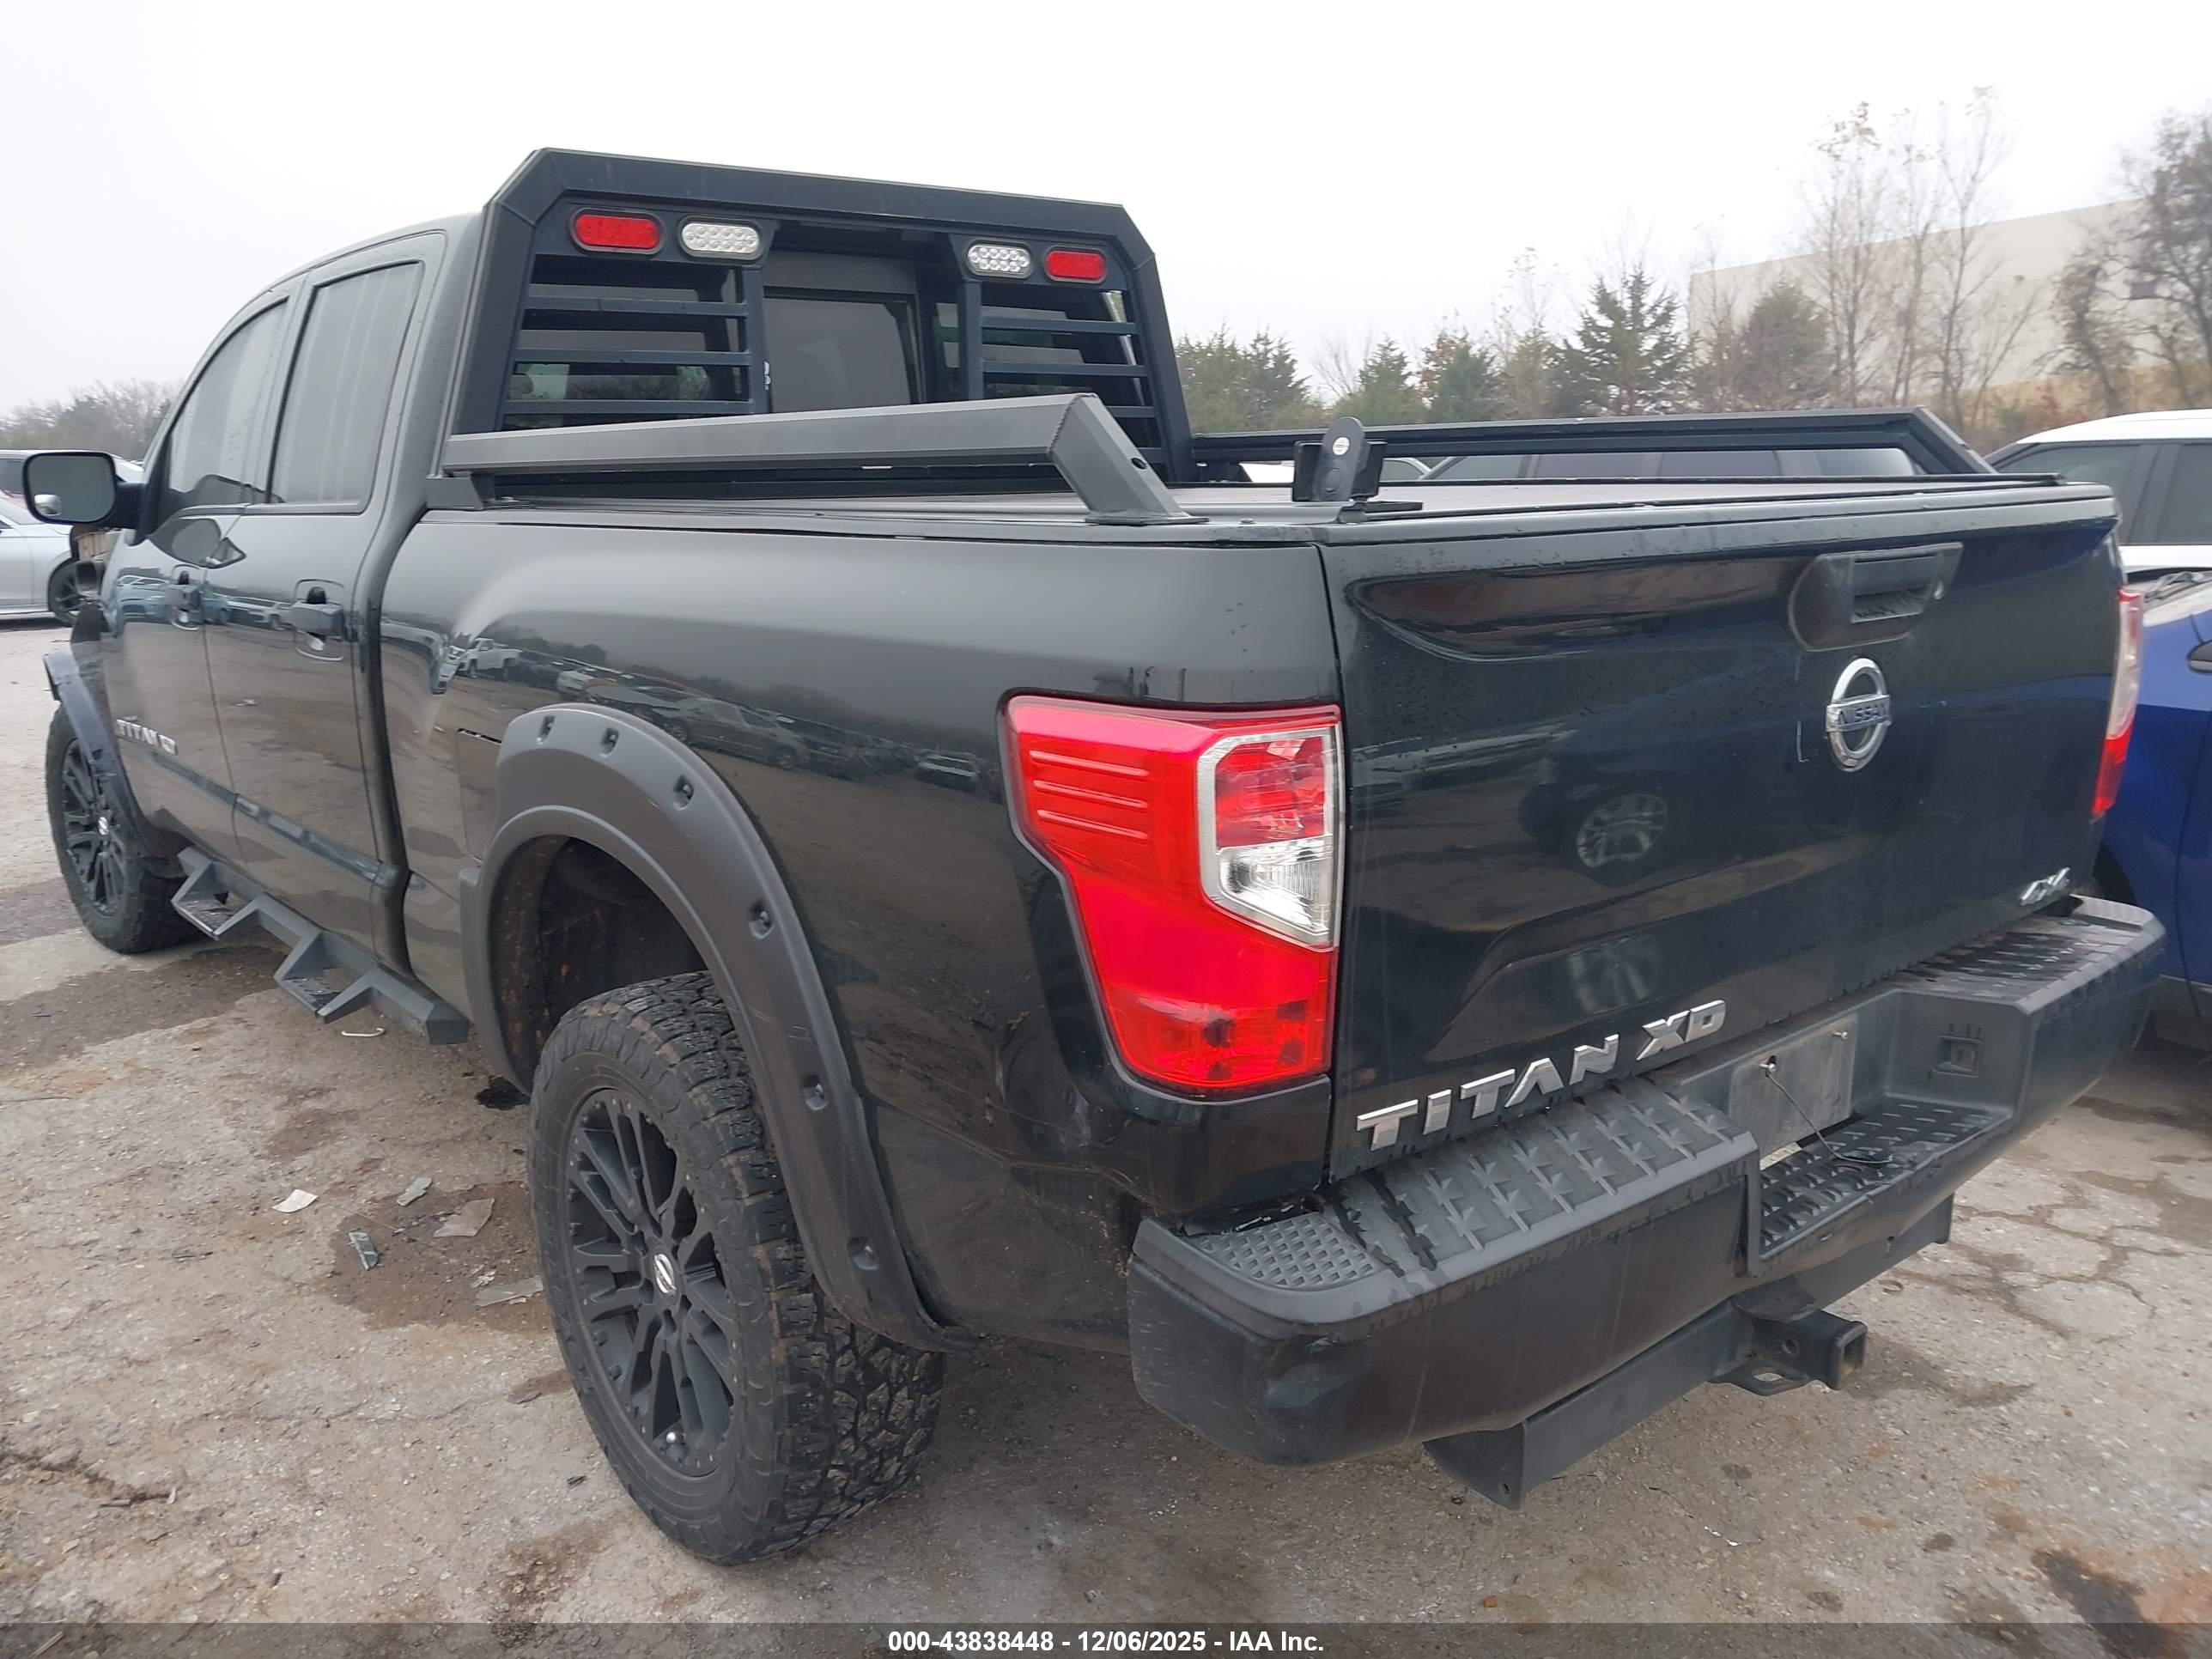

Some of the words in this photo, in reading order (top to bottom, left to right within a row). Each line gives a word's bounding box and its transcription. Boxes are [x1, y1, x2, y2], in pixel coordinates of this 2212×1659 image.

[114, 719, 158, 746] TITAN
[1357, 1033, 1620, 1152] TITAN
[1637, 1000, 1727, 1060] XD
